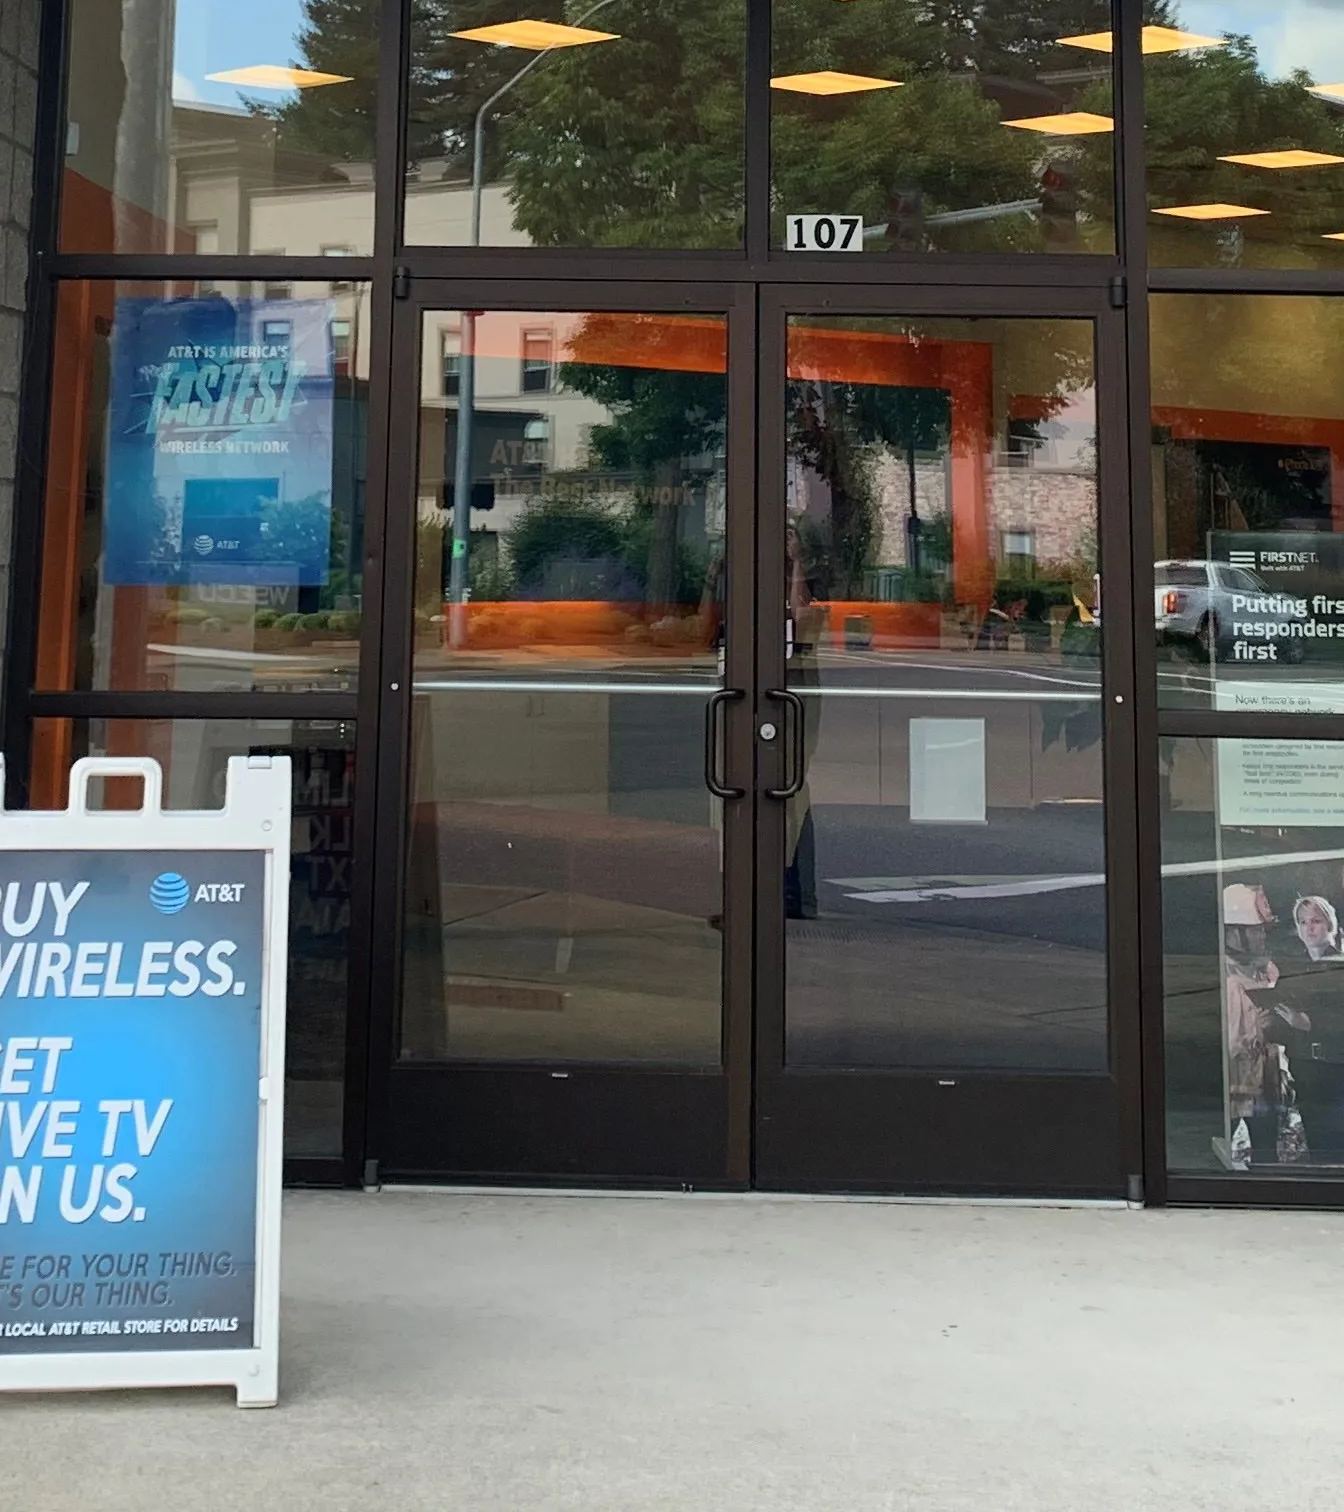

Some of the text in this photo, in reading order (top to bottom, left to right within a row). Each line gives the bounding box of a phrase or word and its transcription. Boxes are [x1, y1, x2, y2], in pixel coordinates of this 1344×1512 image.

[793, 217, 860, 249] 107
[167, 345, 289, 359] AT&T IS AMERICA'S
[145, 360, 306, 434] FASTEST
[159, 440, 290, 454] WIRELESS NETWORK
[216, 540, 241, 550] AT&T
[1232, 595, 1308, 618] Putting
[1233, 640, 1278, 660] first
[1235, 694, 1258, 706] Now
[1297, 697, 1312, 706] an
[194, 883, 245, 903] AT&T
[98, 1098, 175, 1158] TV
[58, 1162, 148, 1225] US.
[21, 1254, 73, 1282] FOR
[82, 1252, 150, 1280] YOUR
[158, 1251, 238, 1278] THING.
[31, 1282, 86, 1310] OUR
[95, 1280, 176, 1308] THING.
[5, 1322, 47, 1337] LOCAL
[47, 1321, 81, 1336] AT&T
[81, 1320, 122, 1335] RETAIL
[123, 1319, 163, 1334] STORE
[163, 1318, 189, 1333] FOR
[190, 1317, 239, 1332] DETAILS
